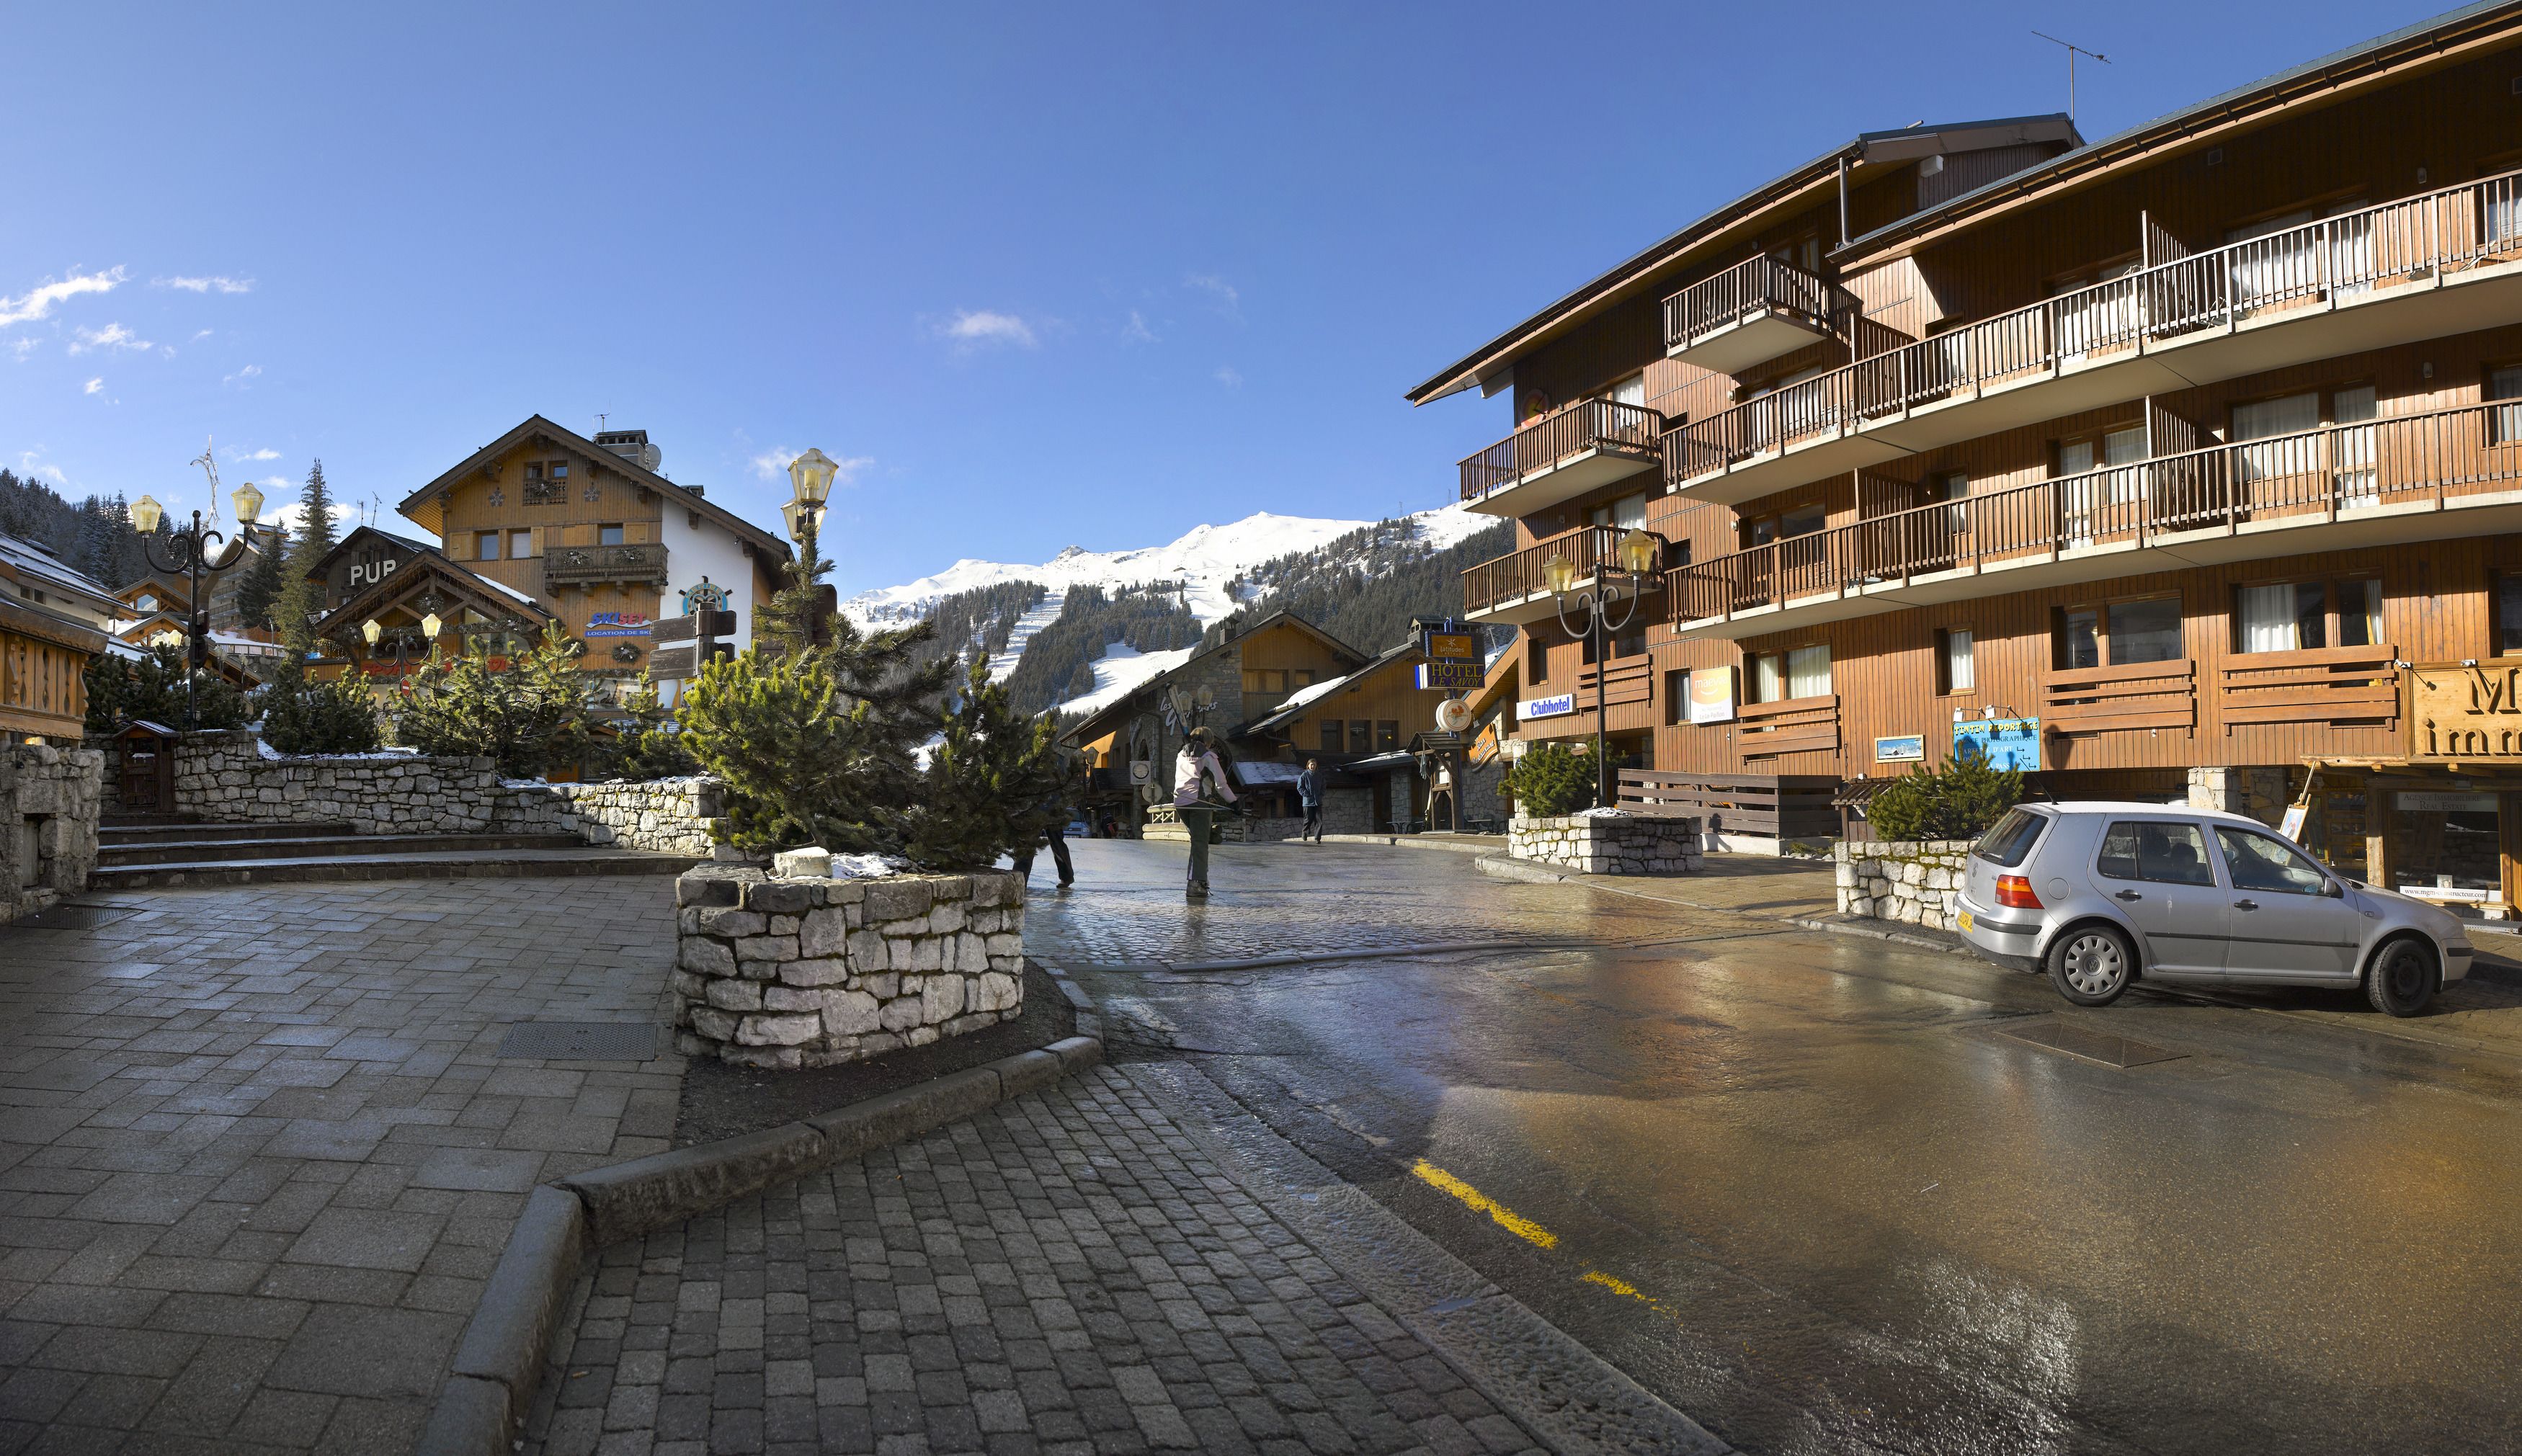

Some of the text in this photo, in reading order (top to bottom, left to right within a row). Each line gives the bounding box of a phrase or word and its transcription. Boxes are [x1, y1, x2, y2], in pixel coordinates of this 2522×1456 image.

[591, 611, 646, 625] SKISET
[1432, 664, 1482, 677] HOTEL
[1432, 677, 1481, 687] LE SAVOY
[1531, 697, 1570, 716] Clubhotel
[1955, 721, 2038, 735] TINTIN REPORTAGE
[1982, 735, 2038, 743] PHOTOGRAPHIQUE
